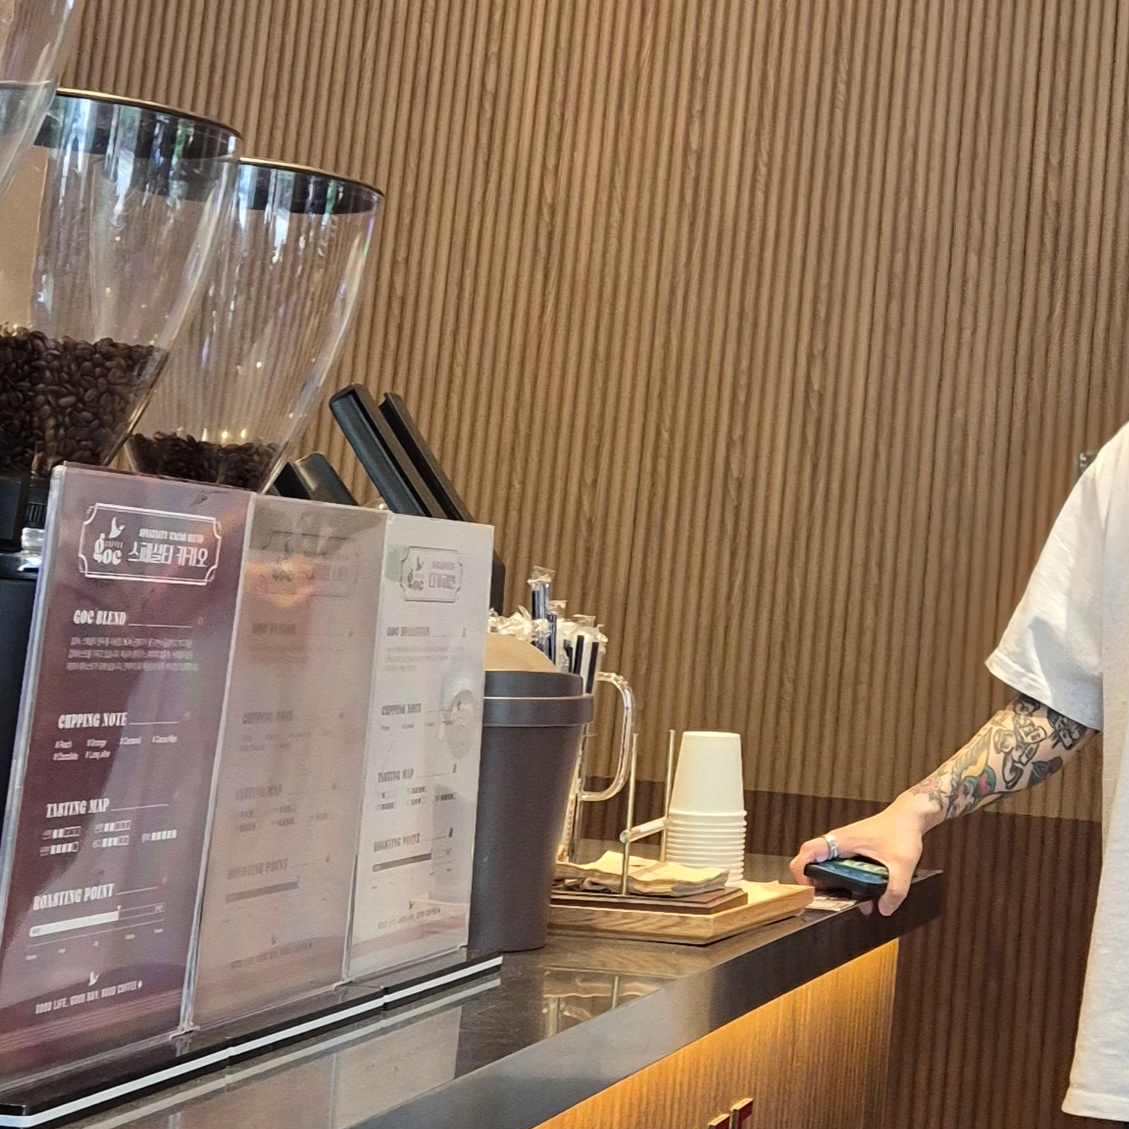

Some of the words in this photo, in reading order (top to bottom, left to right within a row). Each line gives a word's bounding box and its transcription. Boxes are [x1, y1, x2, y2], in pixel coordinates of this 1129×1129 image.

[176, 545, 209, 568] 카카오
[73, 609, 95, 625] GOC
[95, 610, 127, 626] BLEND
[57, 713, 100, 730] CUPPING
[101, 711, 128, 728] NOTE
[46, 800, 87, 819] TASTING
[88, 798, 110, 814] MAP
[33, 889, 83, 911] ROASTING
[83, 883, 115, 902] POINT
